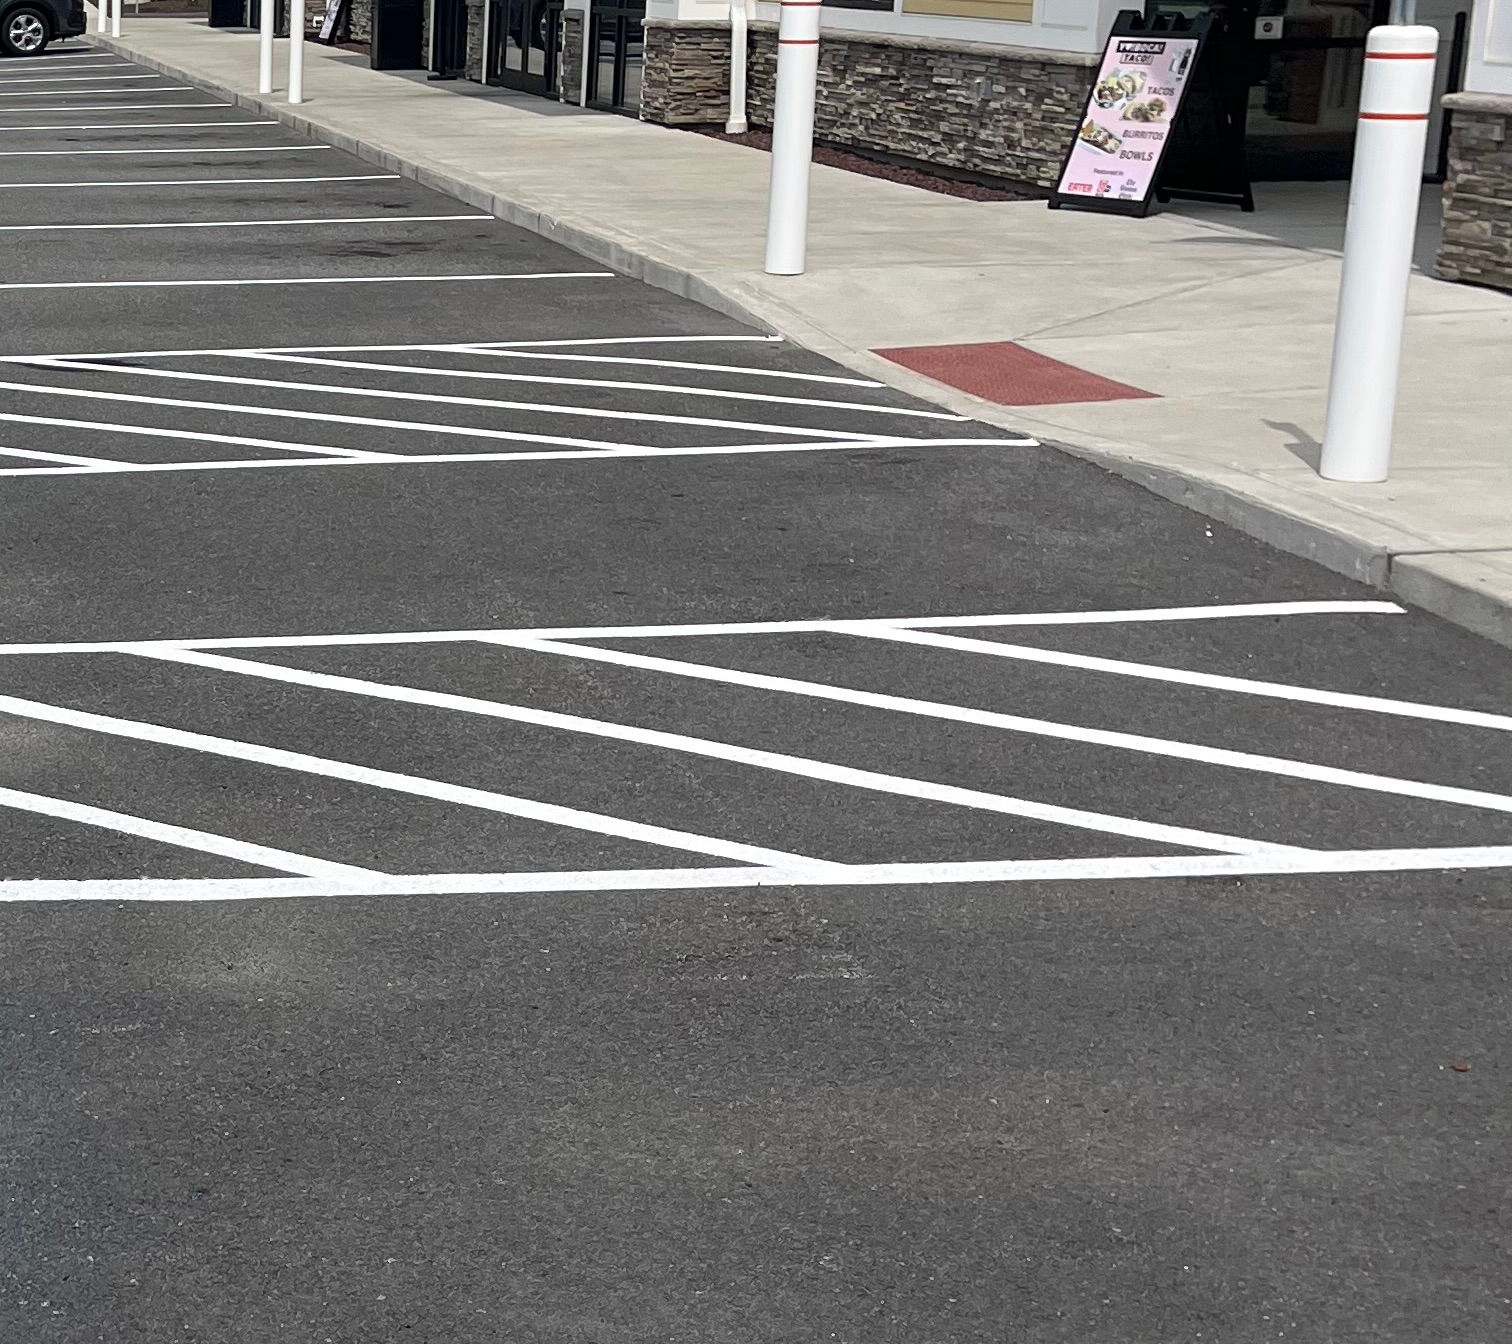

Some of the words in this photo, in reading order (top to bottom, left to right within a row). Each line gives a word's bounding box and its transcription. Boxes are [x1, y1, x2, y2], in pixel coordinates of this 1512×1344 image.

[1147, 86, 1175, 97] TACOS
[1122, 129, 1165, 141] BURRITOS
[1119, 150, 1155, 162] BOWLS
[1068, 181, 1094, 193] EATER
